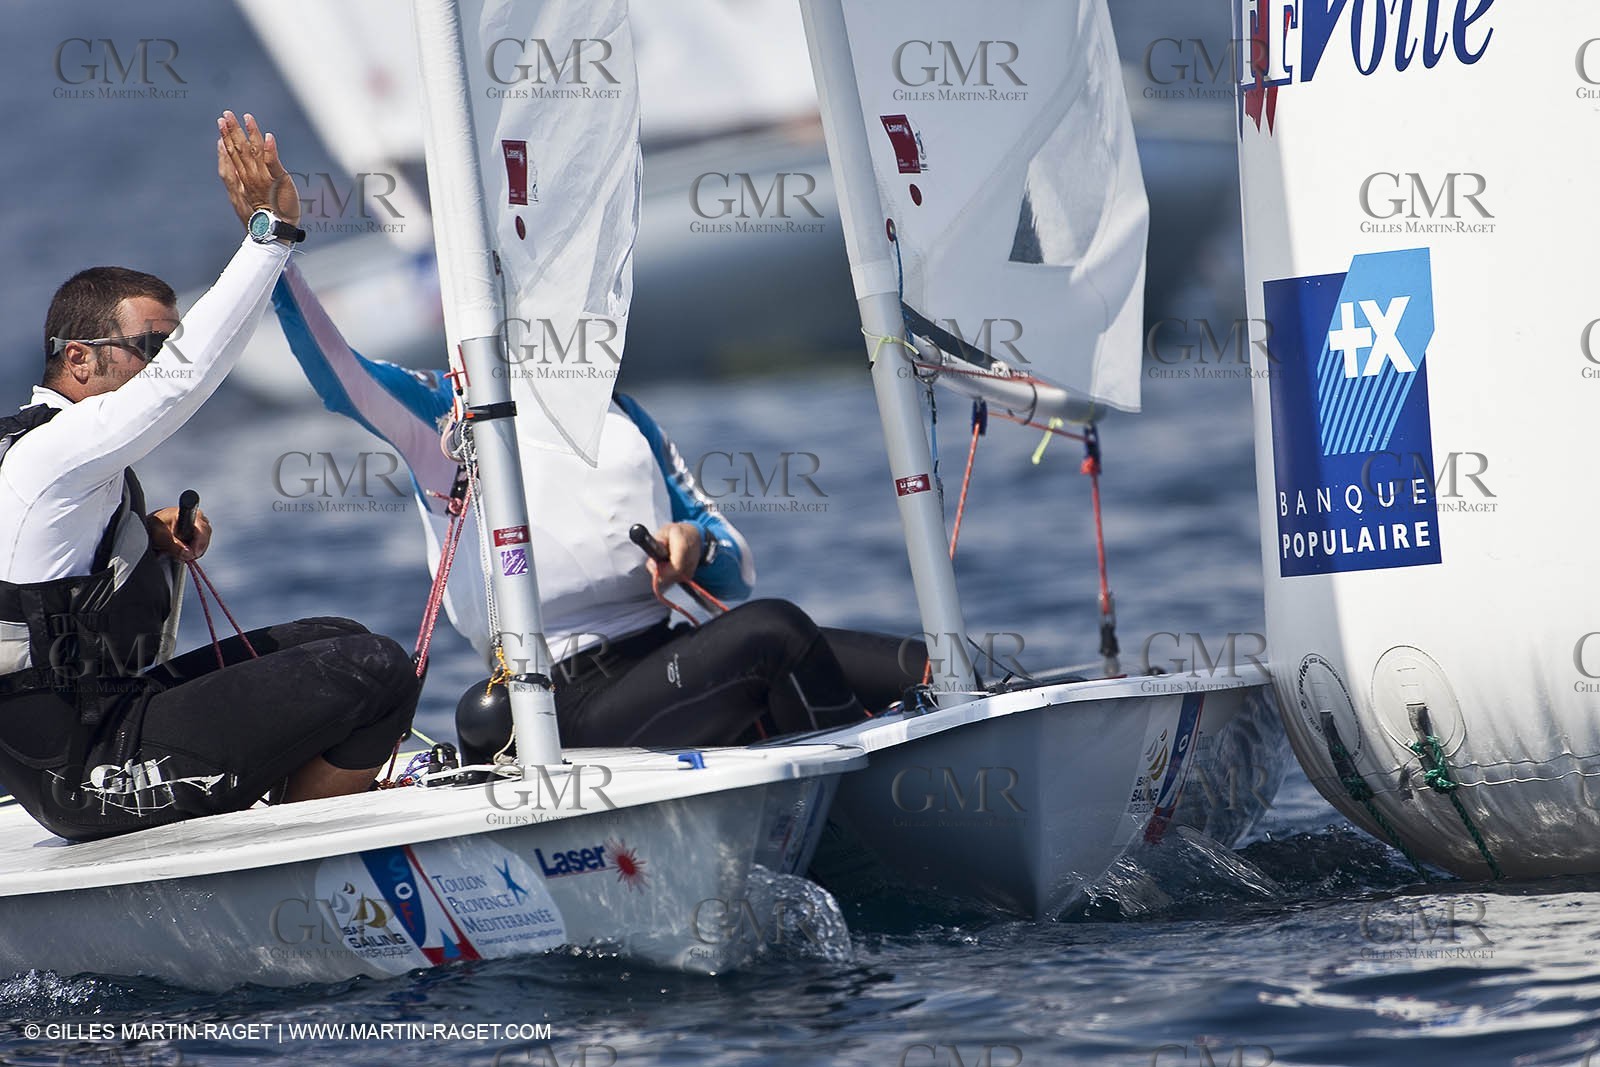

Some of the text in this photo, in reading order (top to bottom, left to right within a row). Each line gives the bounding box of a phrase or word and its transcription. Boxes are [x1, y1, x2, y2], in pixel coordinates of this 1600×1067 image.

[1280, 478, 1427, 516] BANQUE
[1282, 521, 1431, 559] POPULAIRE
[534, 846, 606, 876] Laser
[432, 874, 486, 894] TOULON
[348, 933, 407, 949] SAILING
